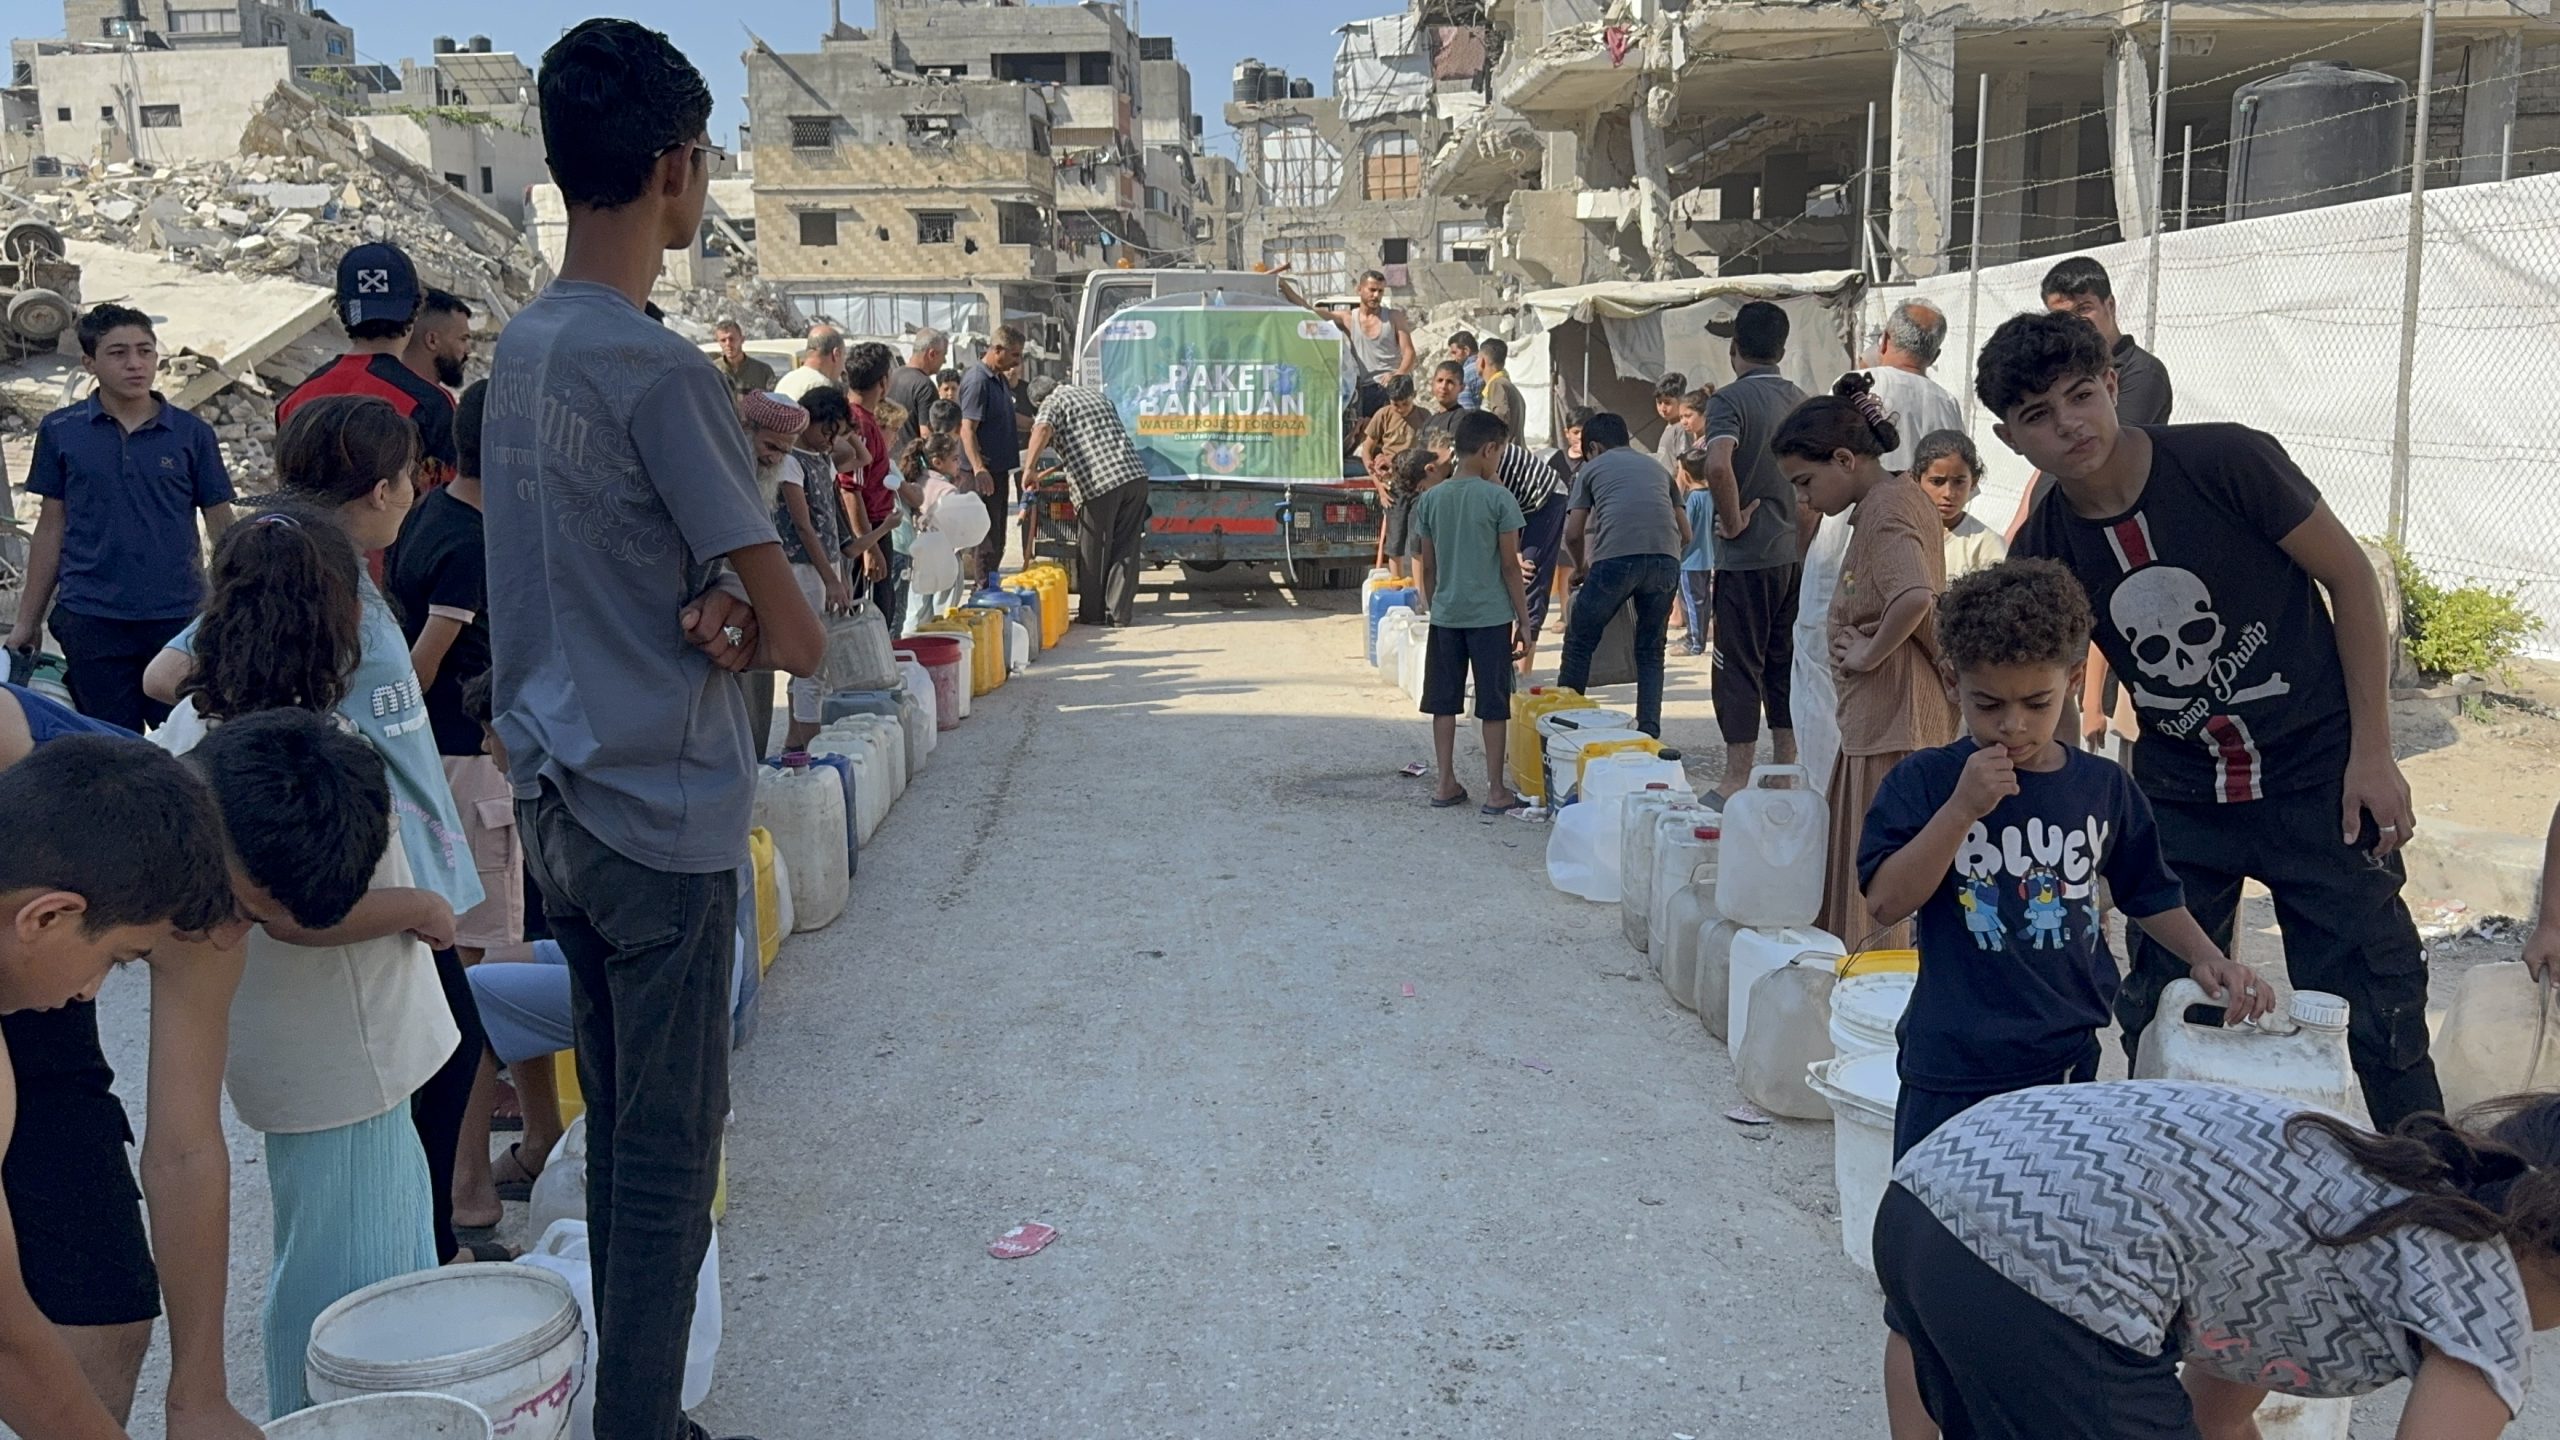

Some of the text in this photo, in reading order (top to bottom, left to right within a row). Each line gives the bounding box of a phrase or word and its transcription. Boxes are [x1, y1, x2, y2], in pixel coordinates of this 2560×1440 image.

[1168, 364, 1277, 391] PAKET
[1140, 391, 1304, 416] BANTUAN
[1140, 418, 1306, 430] WATER PROJECT FOR GAZA
[1174, 433, 1273, 442] Dari Masyarakat Indonesia
[2207, 621, 2268, 701] Philip
[1955, 815, 2109, 883] BLUEY
